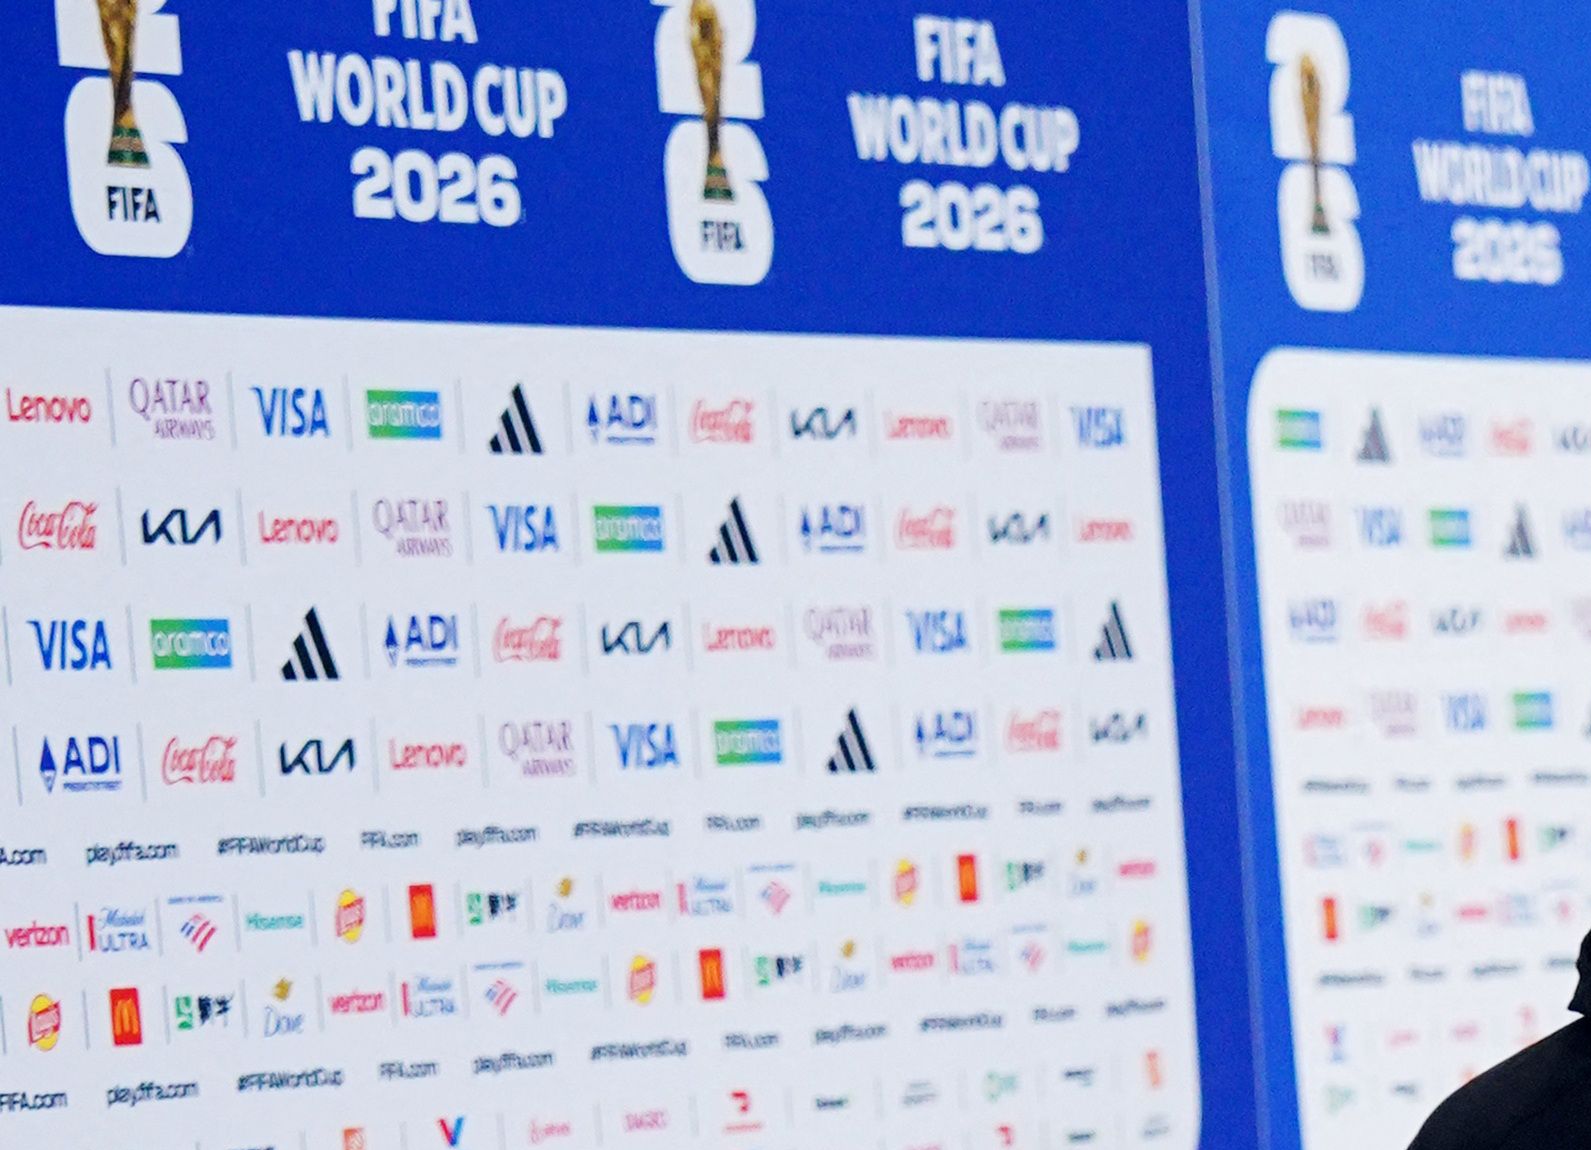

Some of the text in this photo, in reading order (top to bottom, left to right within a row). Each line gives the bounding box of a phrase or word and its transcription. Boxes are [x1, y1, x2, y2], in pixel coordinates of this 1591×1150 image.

[370, 0, 478, 44] FIFA
[913, 14, 1006, 87] FIFA
[288, 50, 568, 138] WORLD CUP
[1461, 69, 1534, 137] FIFA
[847, 92, 1080, 172] WORLD CUP
[350, 146, 522, 227] 2026
[1413, 138, 1591, 214] WORLD CUP
[107, 186, 160, 222] FIFA
[899, 179, 1044, 254] 2026
[1451, 215, 1564, 286] 2026
[7, 389, 90, 422] Lenovo
[128, 378, 212, 417] QATAR
[253, 387, 328, 436] VISA
[367, 402, 442, 428] aramco
[608, 394, 655, 427] ADI
[258, 513, 338, 543] Lenovo
[489, 505, 556, 551] VISA
[29, 620, 111, 670] VISA
[153, 630, 228, 657] aramco
[405, 615, 458, 647] ADI
[63, 736, 120, 775] ADI
[392, 744, 465, 769] Lenovo
[612, 724, 678, 768] VISA
[6, 923, 68, 947] verizon
[102, 932, 149, 952] ULTRA
